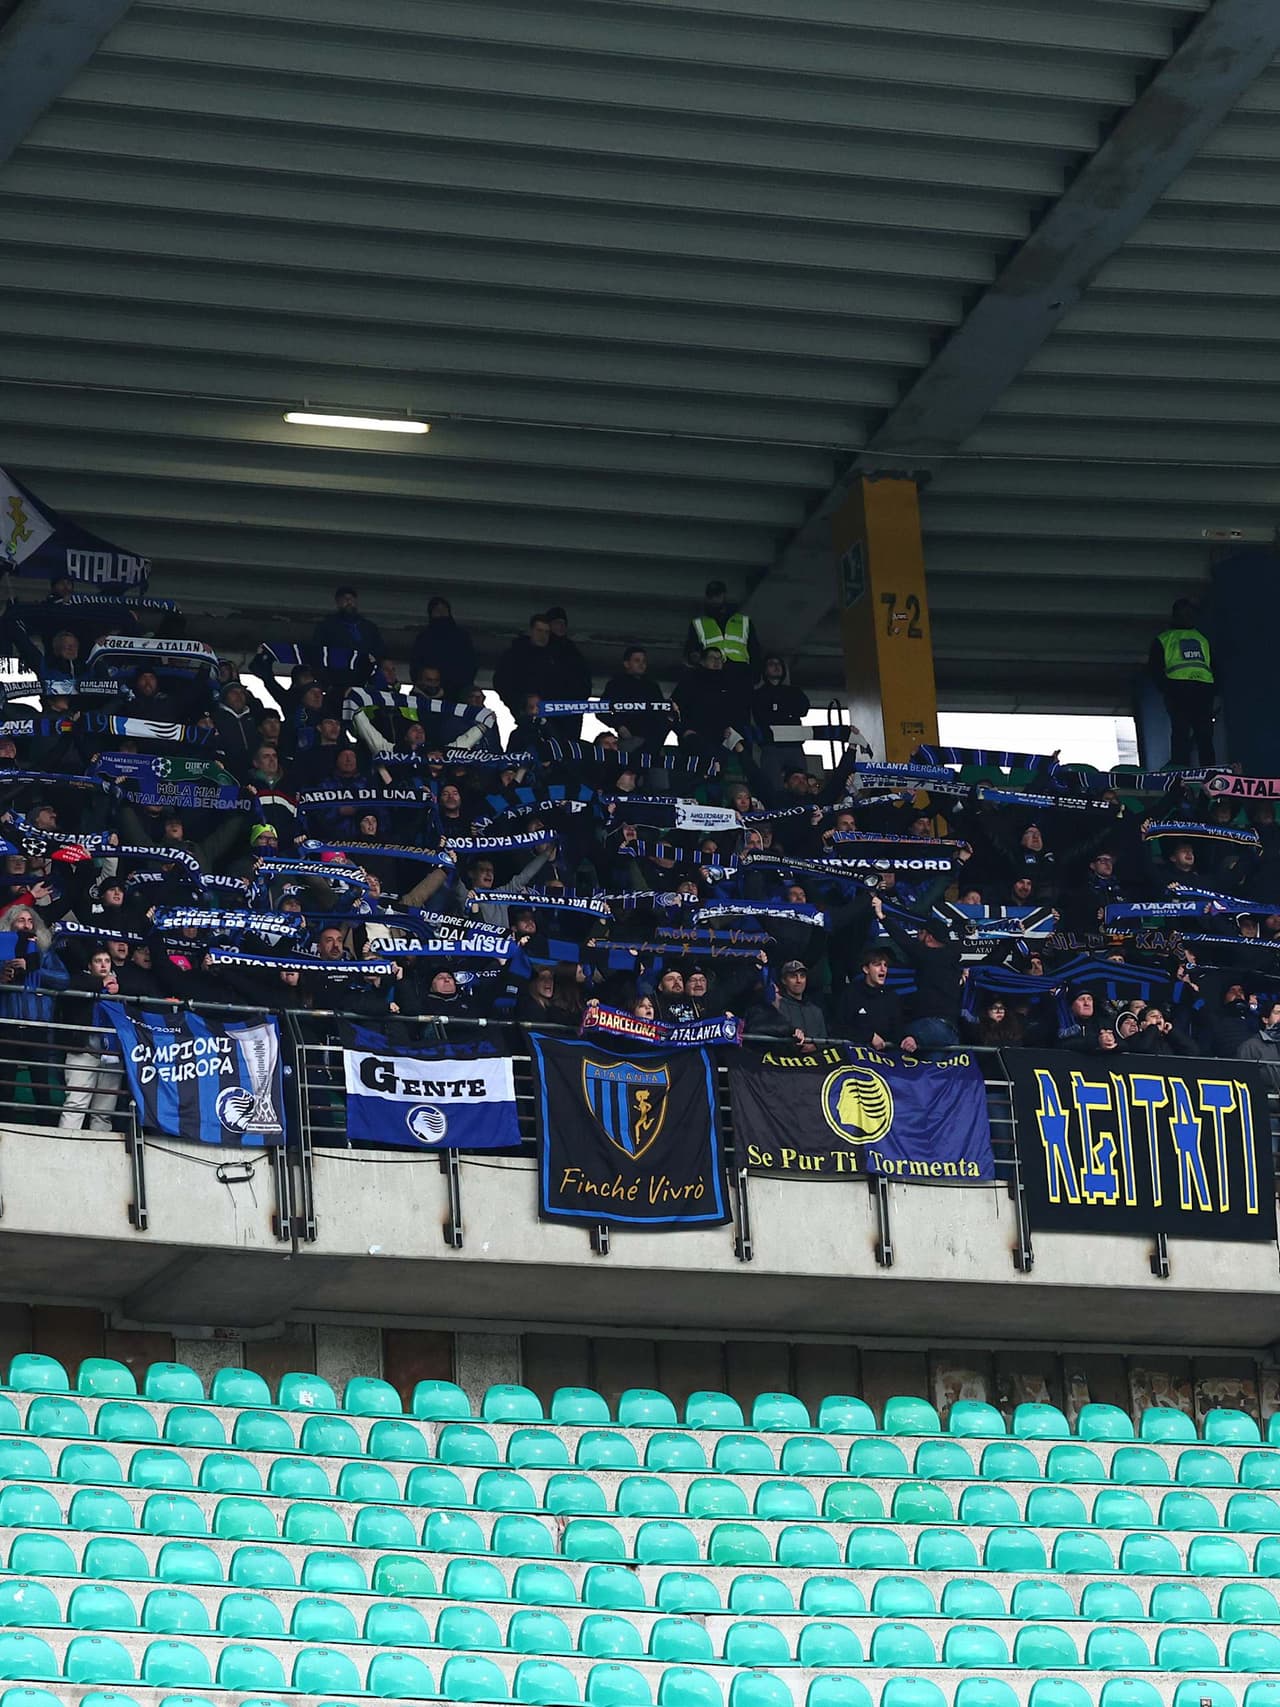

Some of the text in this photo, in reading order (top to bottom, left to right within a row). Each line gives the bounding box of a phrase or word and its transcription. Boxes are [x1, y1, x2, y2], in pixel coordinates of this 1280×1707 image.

[880, 593, 922, 638] 72
[866, 762, 949, 774] ATALANTA BERGAMO
[893, 858, 952, 872] NORD
[428, 939, 456, 952] DE
[599, 1013, 656, 1037] BARCELONA
[670, 1023, 722, 1041] ATALANTA
[130, 1036, 232, 1064] CAMPIONI
[761, 1050, 818, 1067] Ama
[824, 1048, 841, 1065] il
[593, 1067, 660, 1083] ATALANTA
[746, 1144, 981, 1177] Se Pur Ti Tormenta
[559, 1167, 706, 1205] Finché Vivrò
